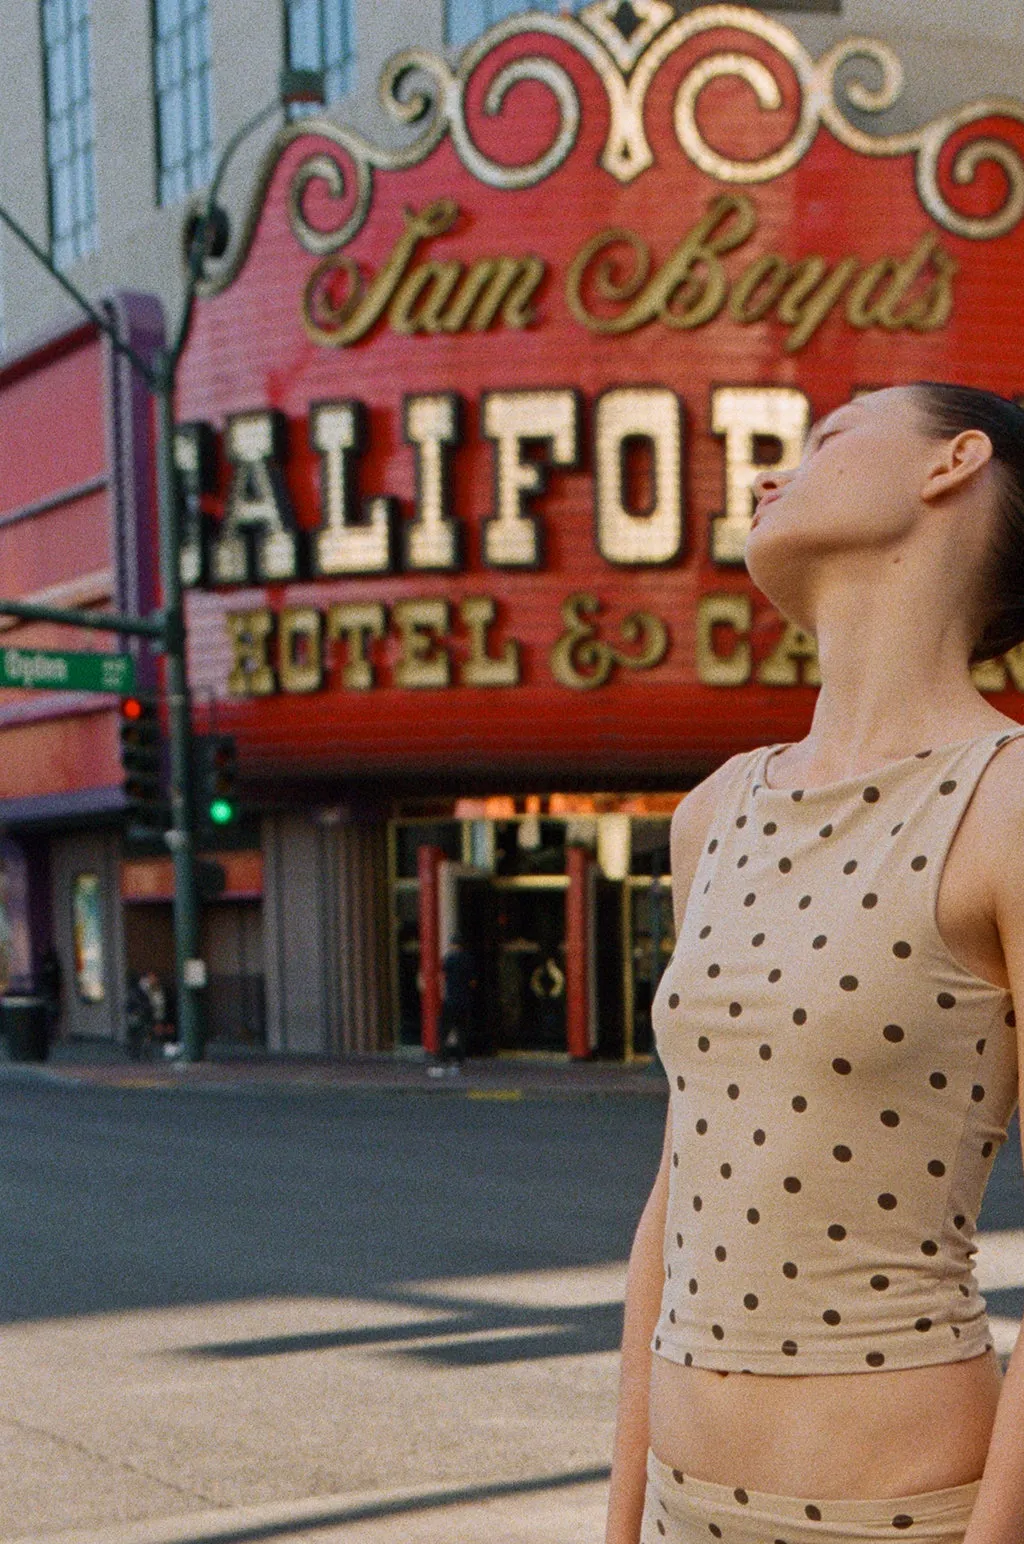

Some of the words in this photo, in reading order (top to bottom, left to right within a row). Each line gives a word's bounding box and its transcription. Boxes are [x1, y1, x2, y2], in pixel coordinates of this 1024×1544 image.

[303, 199, 546, 349] Sam
[226, 597, 520, 694] HOTEL
[551, 594, 667, 691] &
